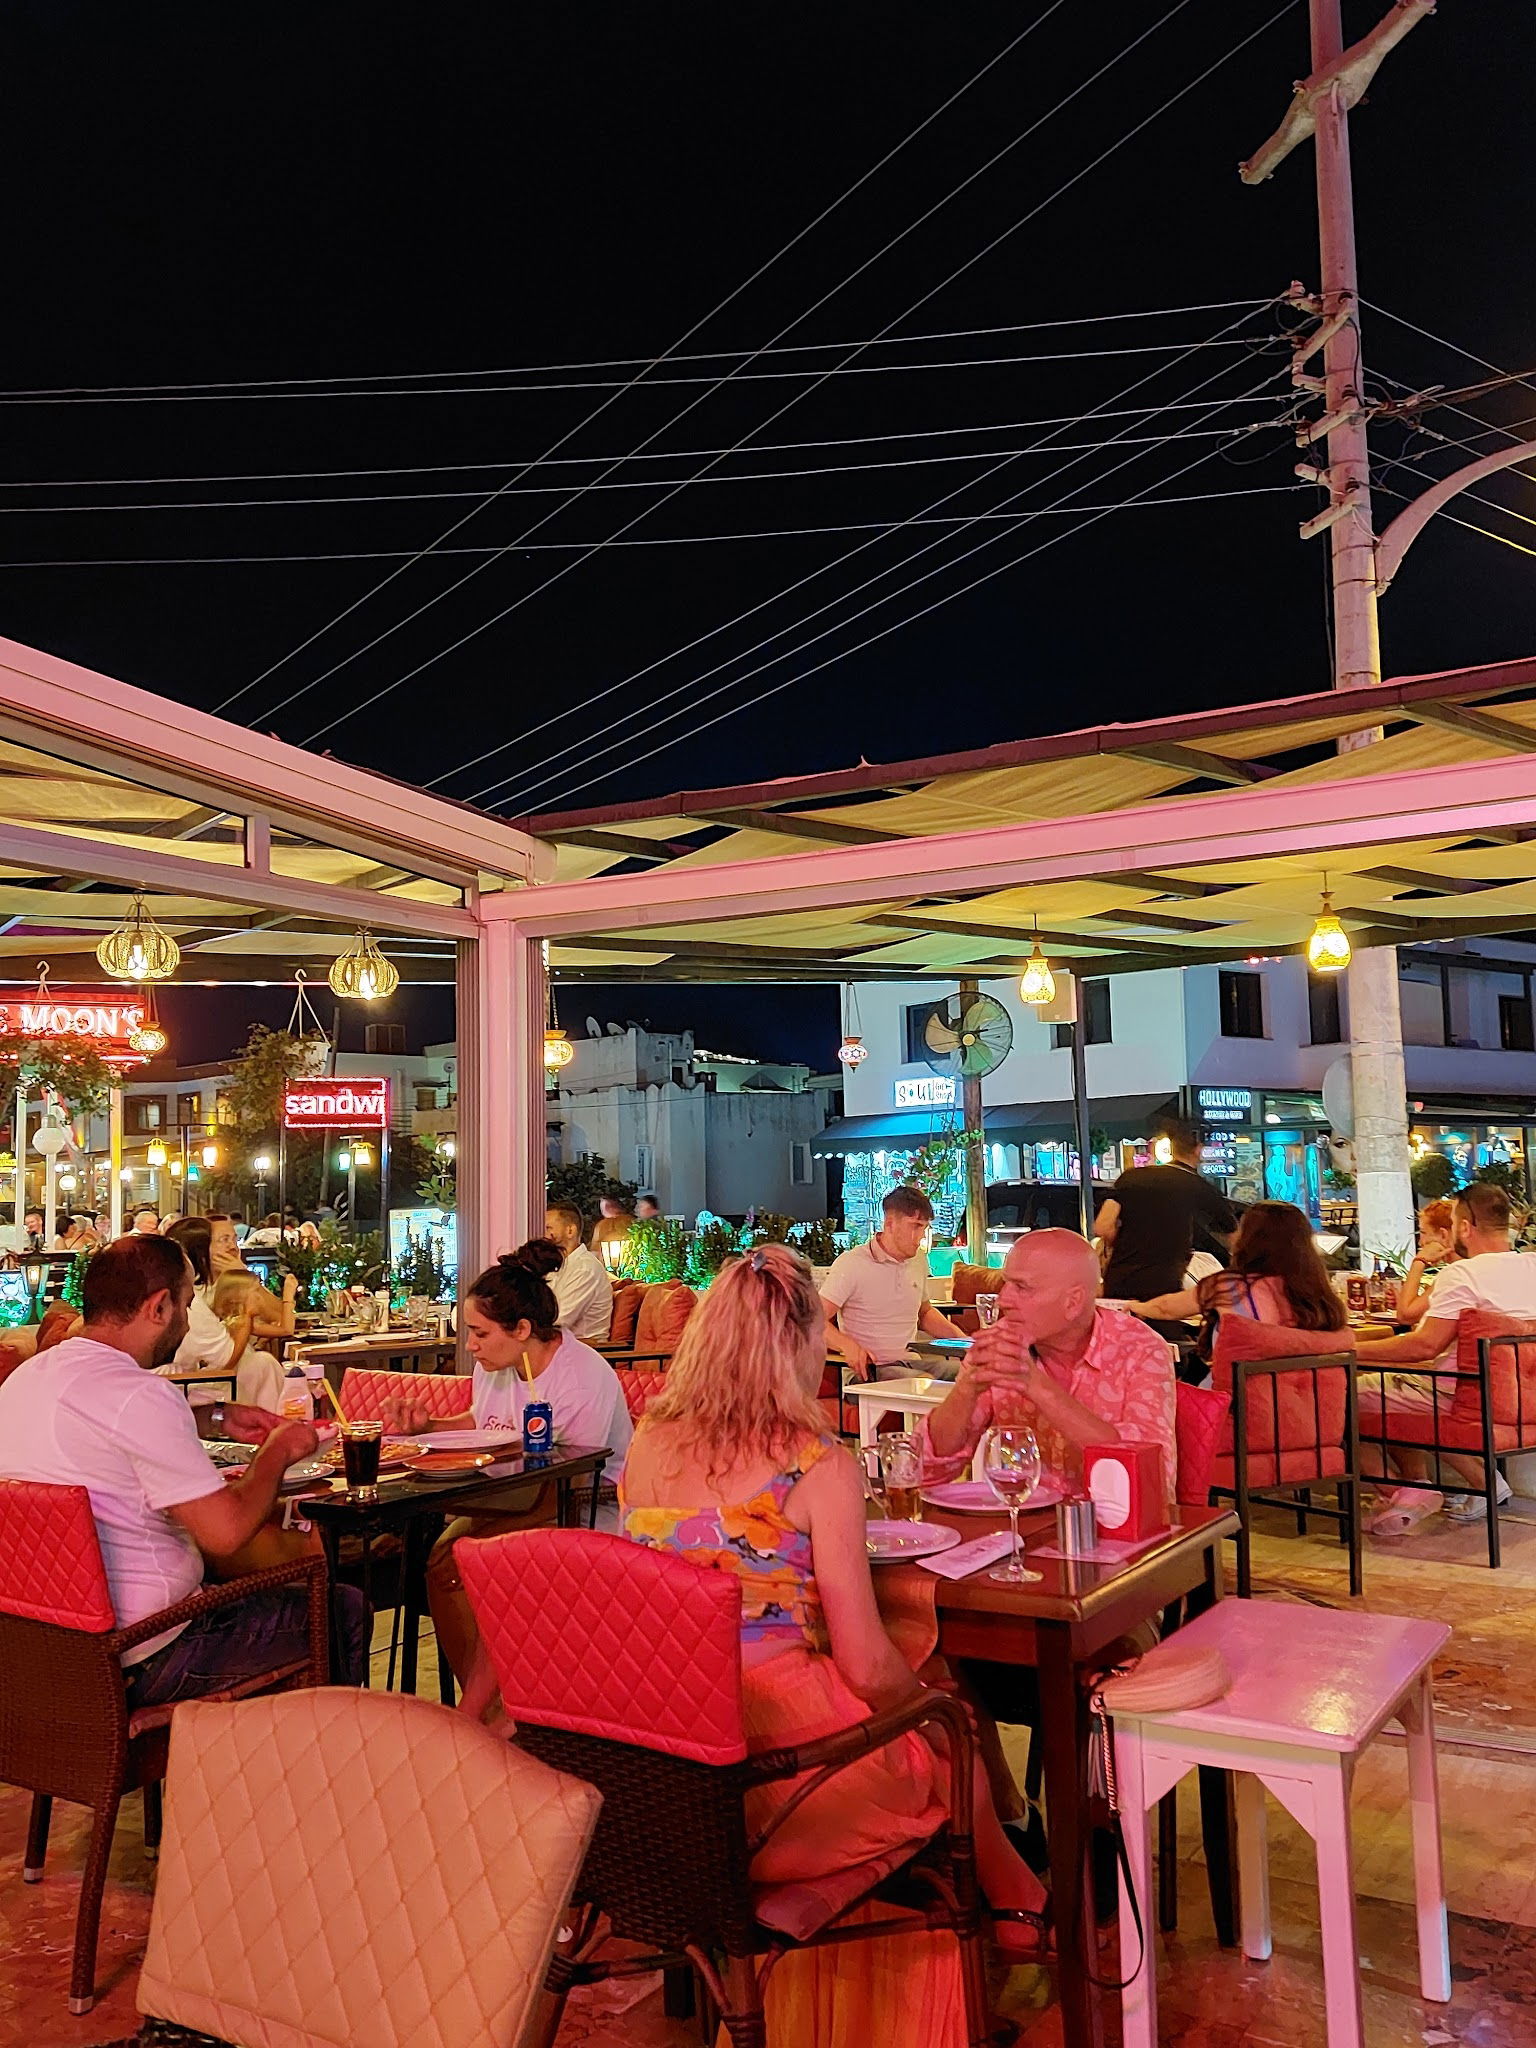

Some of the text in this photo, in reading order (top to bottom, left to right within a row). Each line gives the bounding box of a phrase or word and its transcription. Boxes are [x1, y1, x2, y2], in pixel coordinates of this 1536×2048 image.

[20, 1005, 145, 1037] MOON'S
[285, 1088, 385, 1114] sandwi
[1199, 1090, 1251, 1108] HOLLYWOOD
